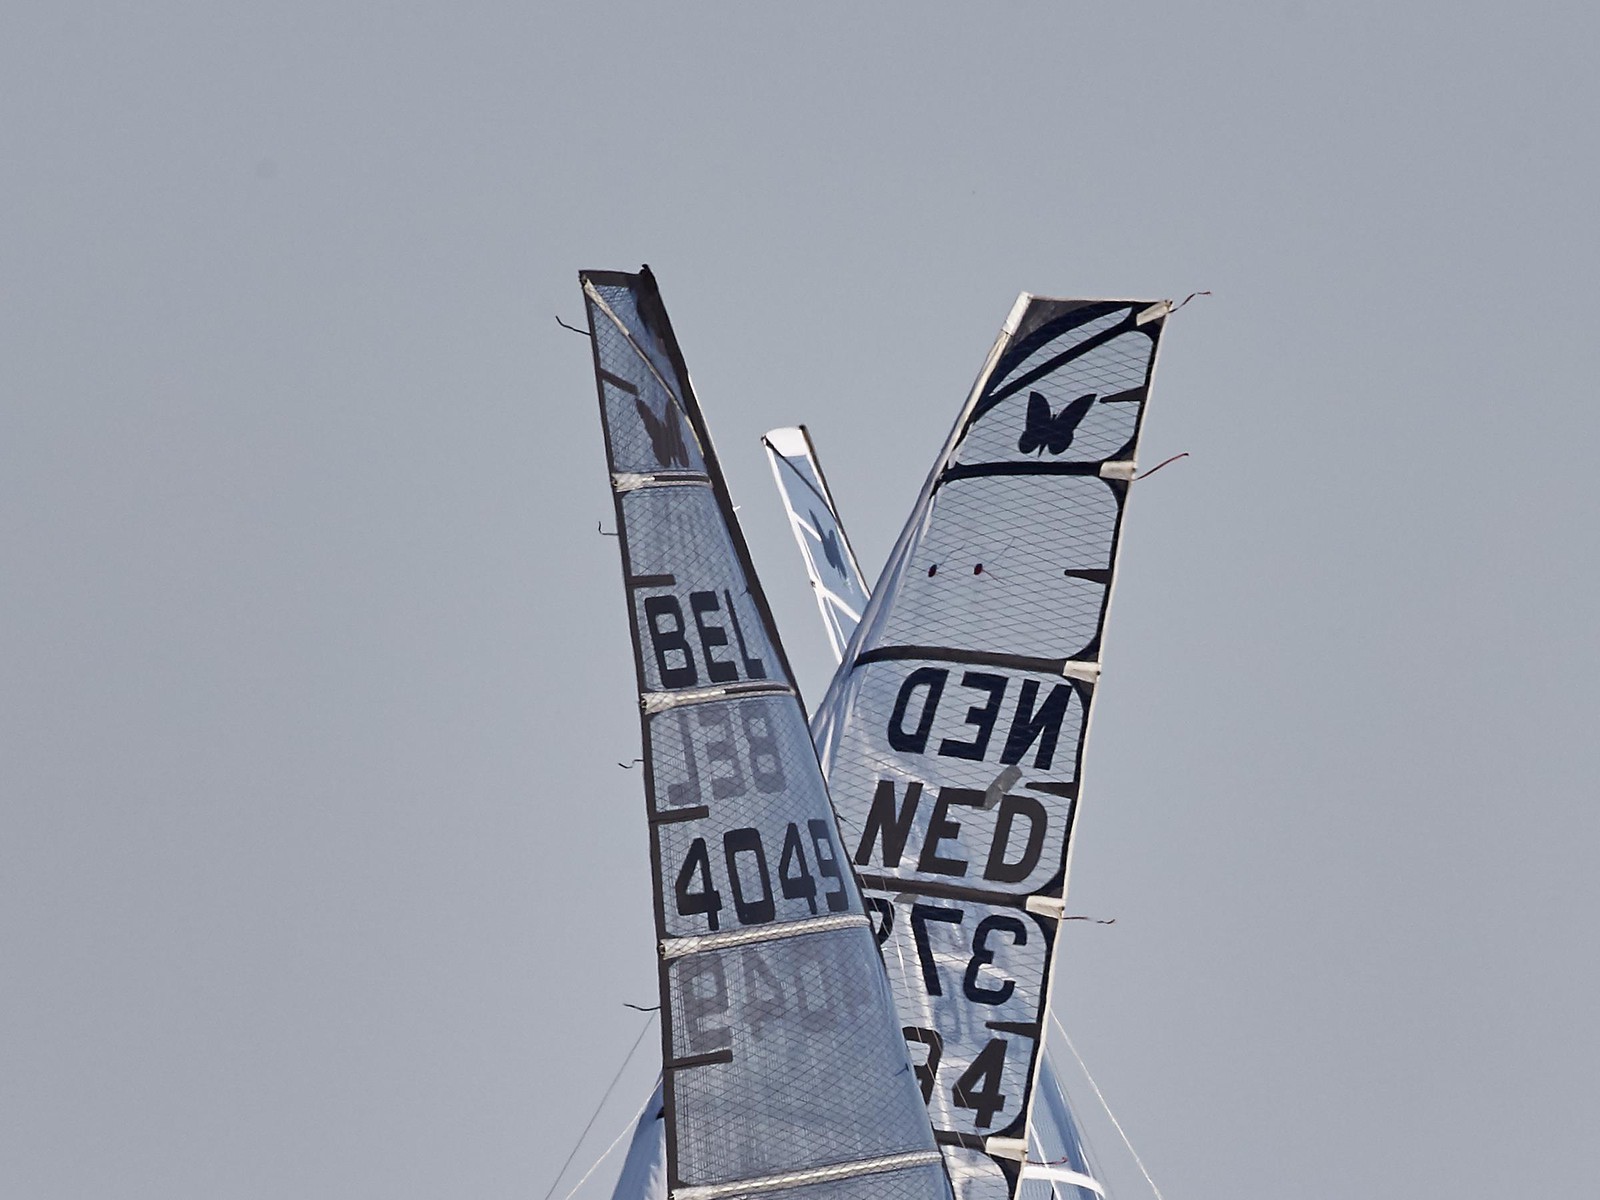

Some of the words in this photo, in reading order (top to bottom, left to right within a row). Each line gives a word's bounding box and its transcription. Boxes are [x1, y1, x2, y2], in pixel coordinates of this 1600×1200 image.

[645, 590, 767, 688] BEL
[675, 819, 848, 932] 4049
[853, 780, 1048, 883] NED
